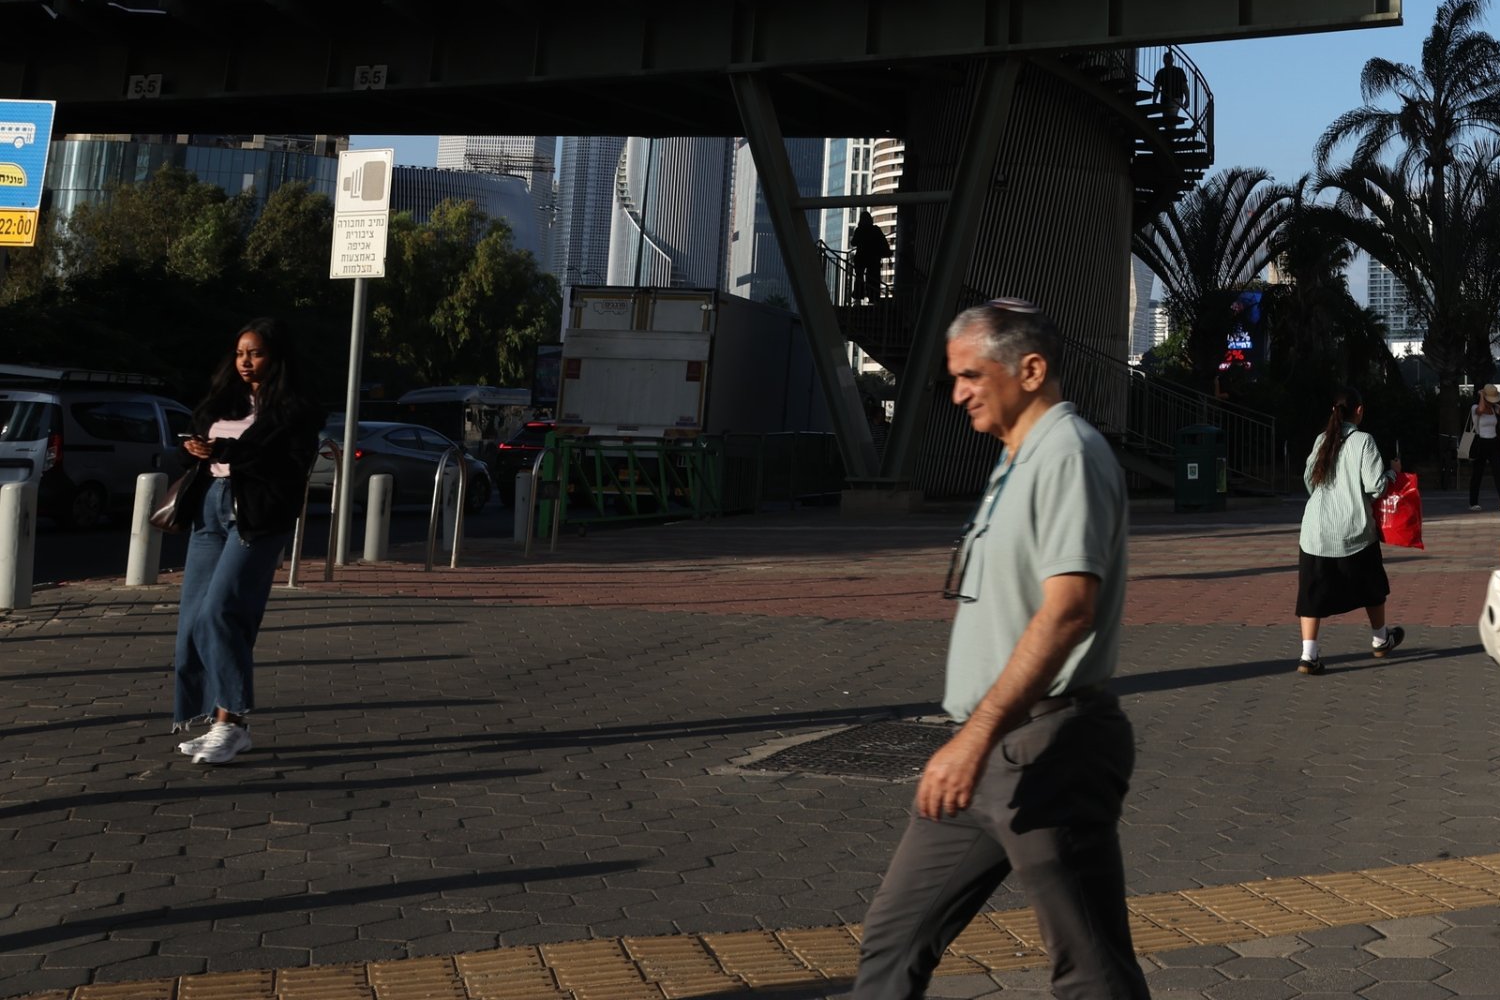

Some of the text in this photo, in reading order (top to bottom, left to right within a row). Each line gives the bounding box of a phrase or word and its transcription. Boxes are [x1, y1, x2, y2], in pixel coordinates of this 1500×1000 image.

[359, 70, 382, 85] 5.5
[134, 79, 157, 94] 5.5
[338, 219, 365, 228] תחבורה
[346, 230, 374, 239] ציבורית
[341, 253, 376, 262] באמצעות
[343, 263, 372, 274] מצלמות
